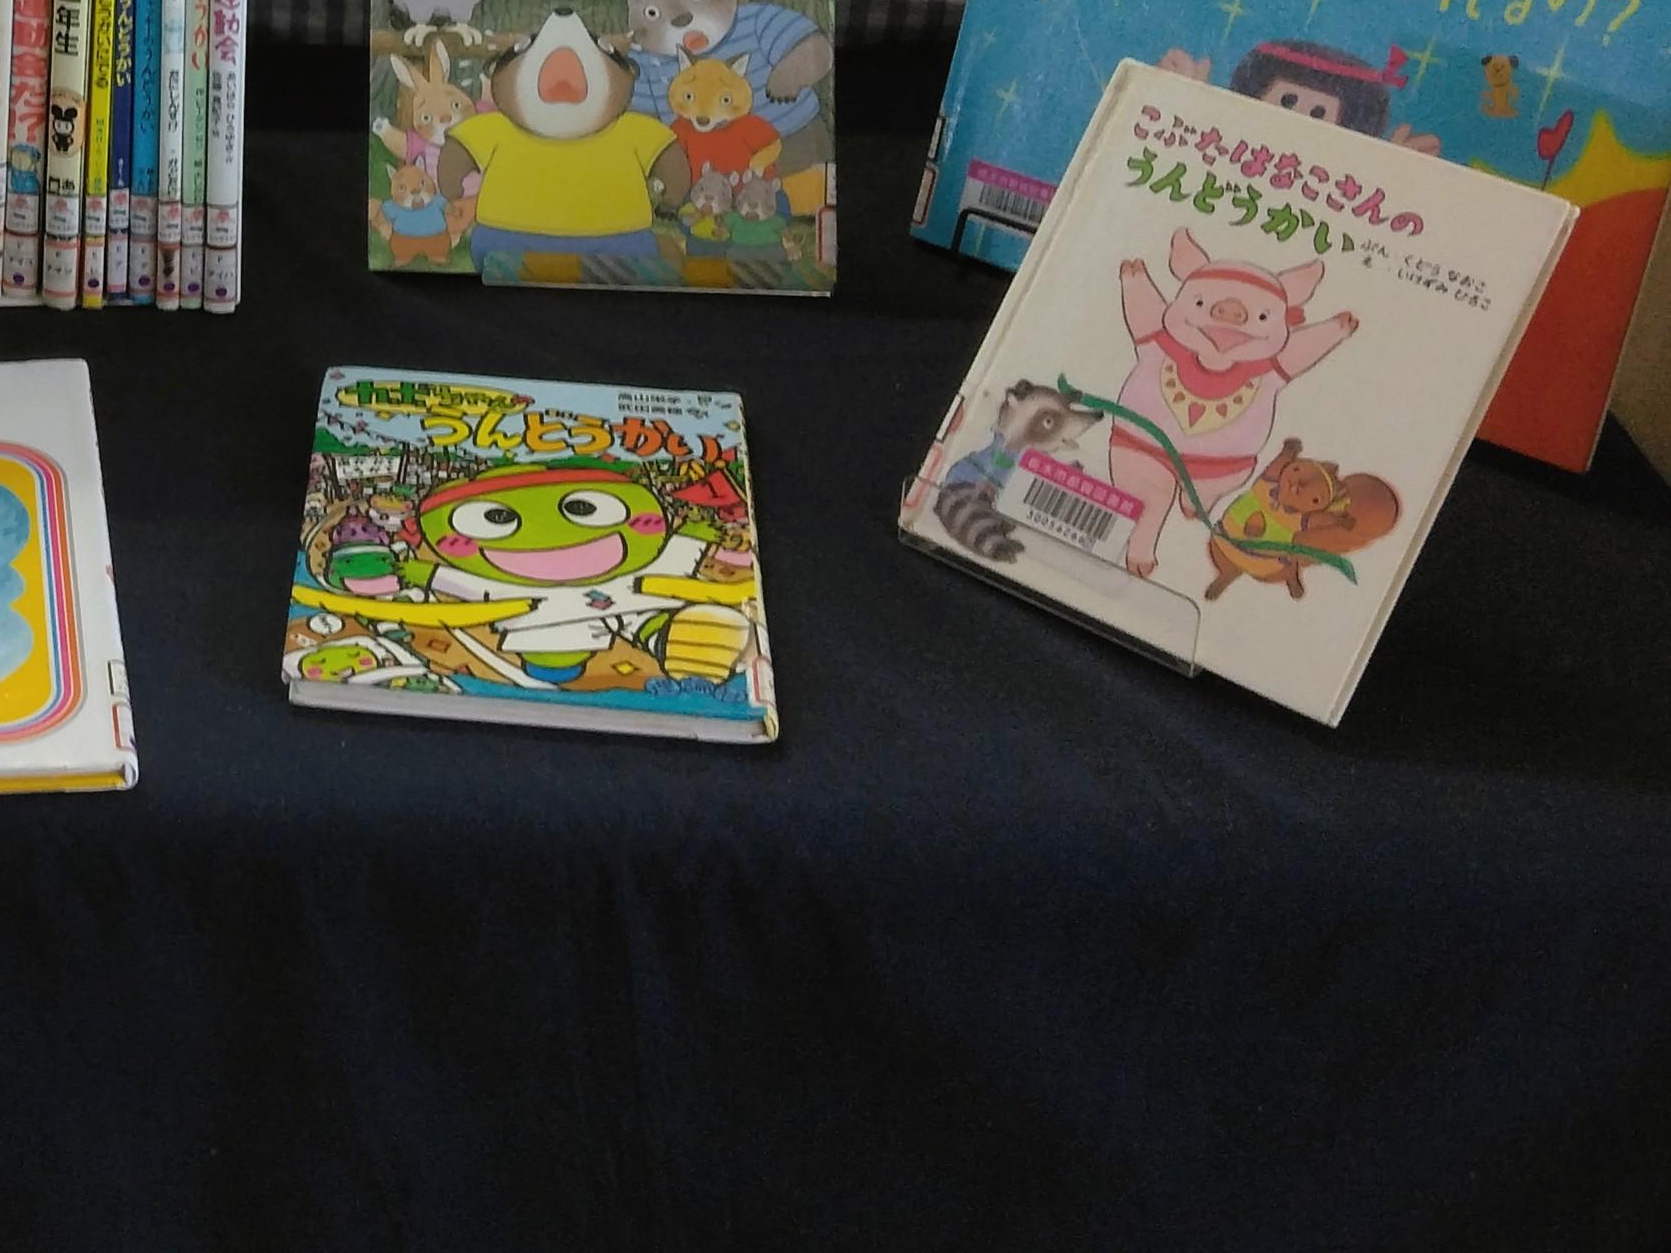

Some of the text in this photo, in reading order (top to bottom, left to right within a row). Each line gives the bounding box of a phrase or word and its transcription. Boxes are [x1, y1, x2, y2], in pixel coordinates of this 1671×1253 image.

[1126, 146, 1356, 255] うんどうかい
[1134, 105, 1425, 236] こぶたはなこさんの
[420, 406, 725, 463] うんどうかい
